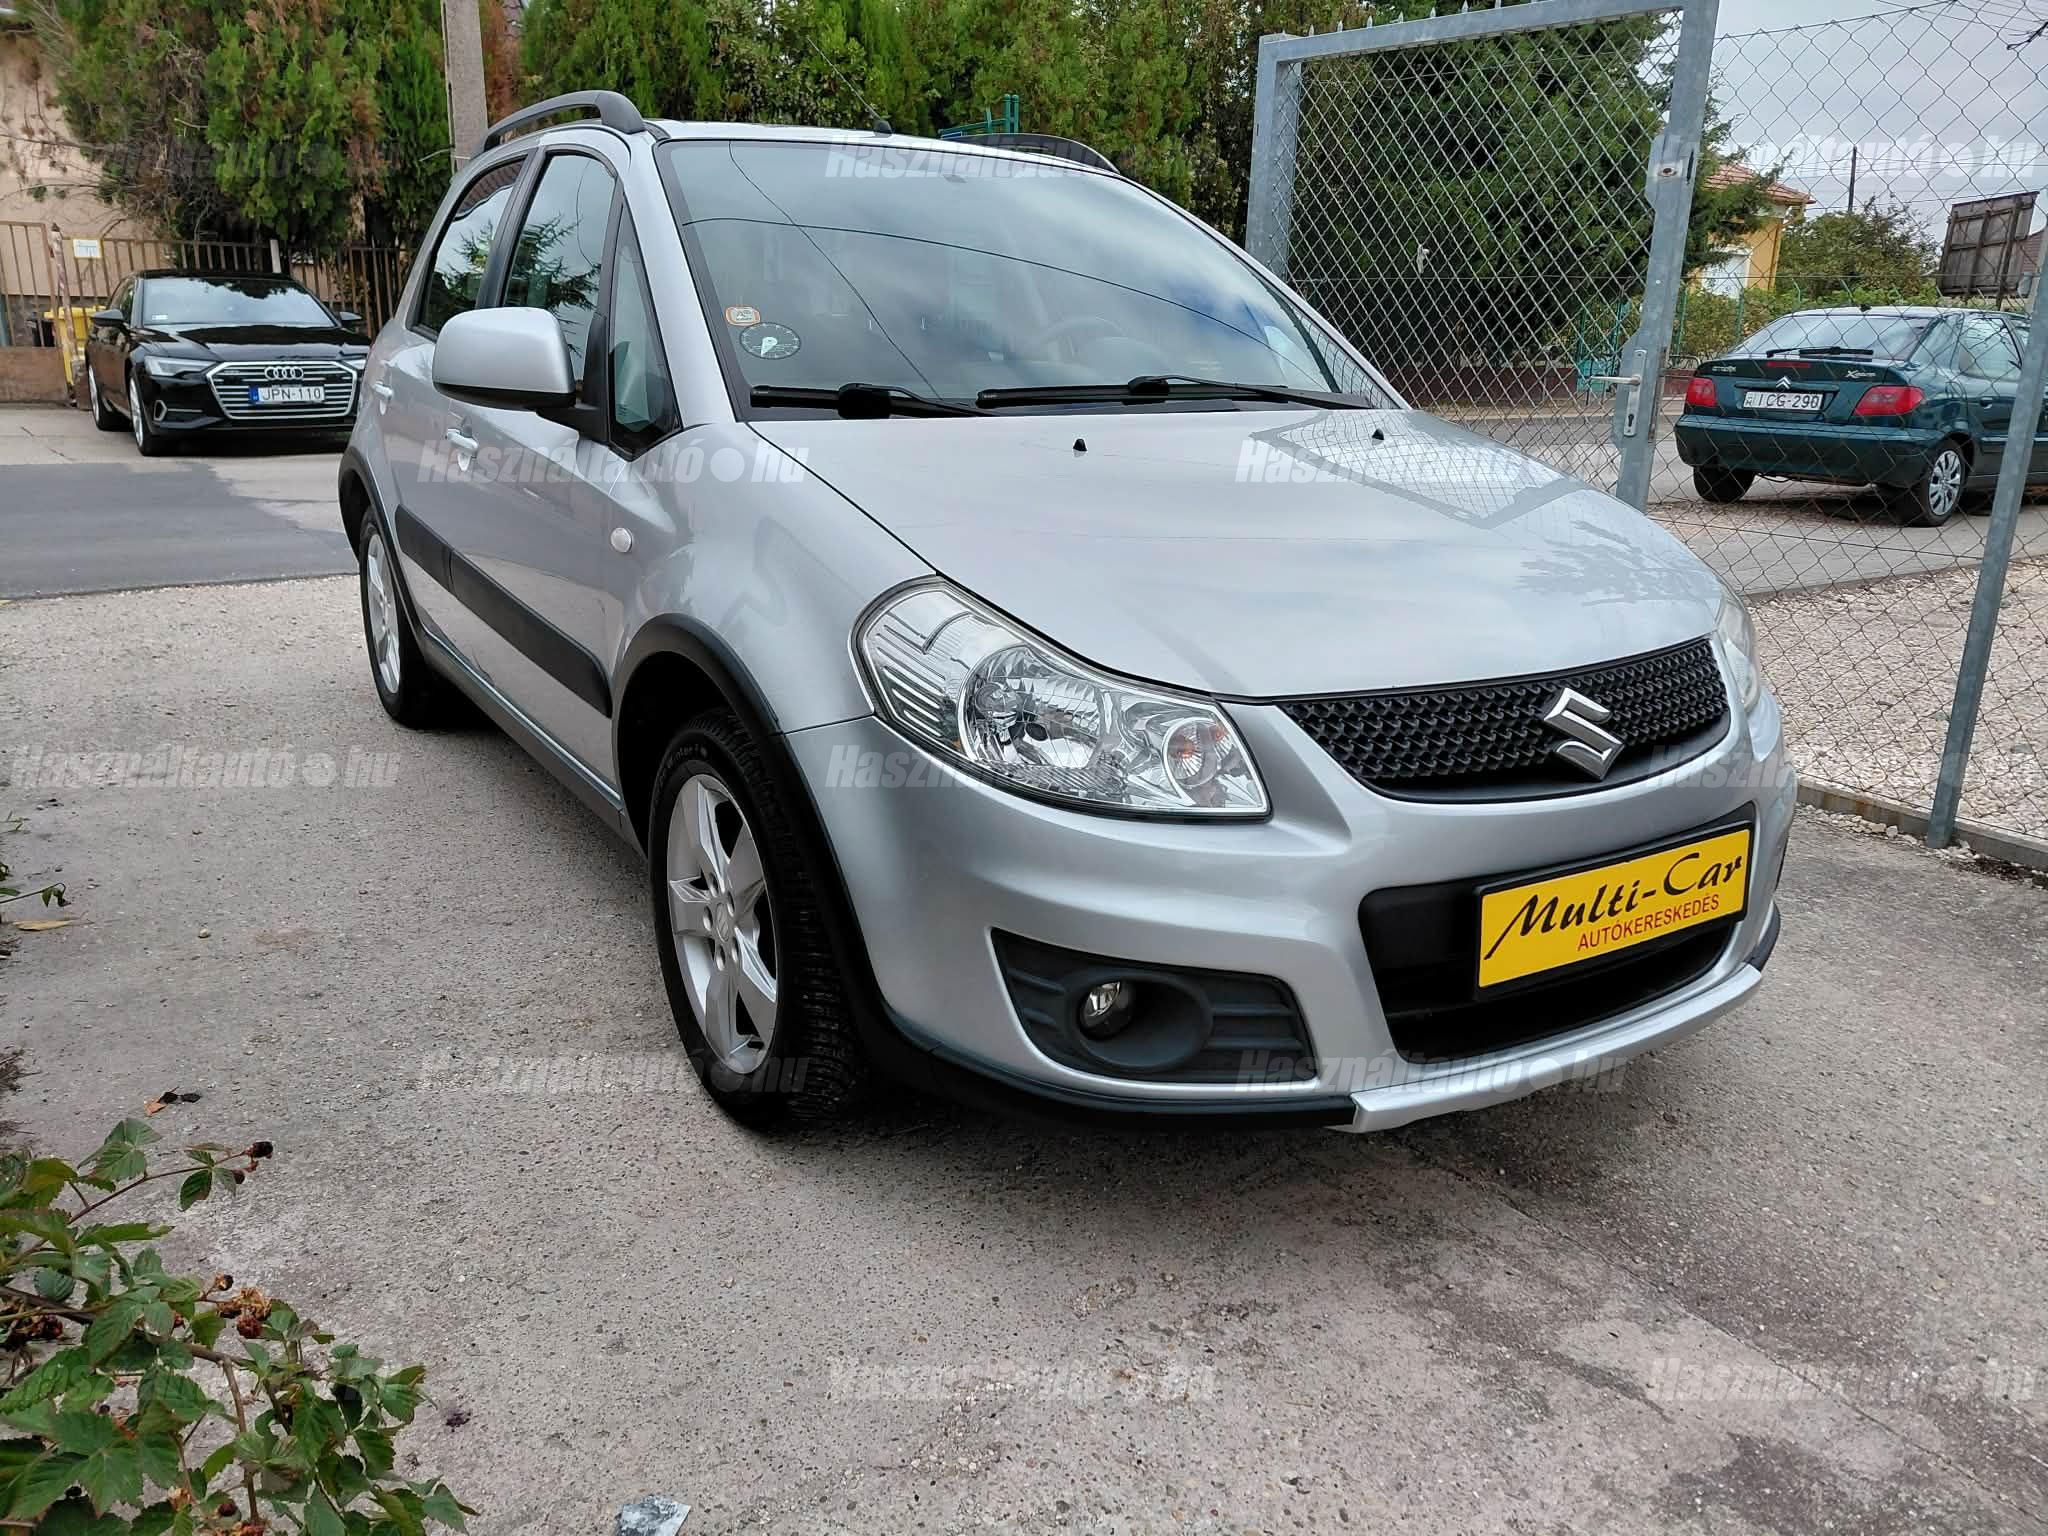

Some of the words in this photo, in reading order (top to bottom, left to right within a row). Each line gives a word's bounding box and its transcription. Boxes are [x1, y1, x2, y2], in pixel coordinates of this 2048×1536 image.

[262, 387, 321, 401] JPN-110
[1758, 393, 1819, 408] ICG-290
[1484, 852, 1742, 960] Multi-Car
[1577, 894, 1720, 952] AUTÓKERESKEDÉS
